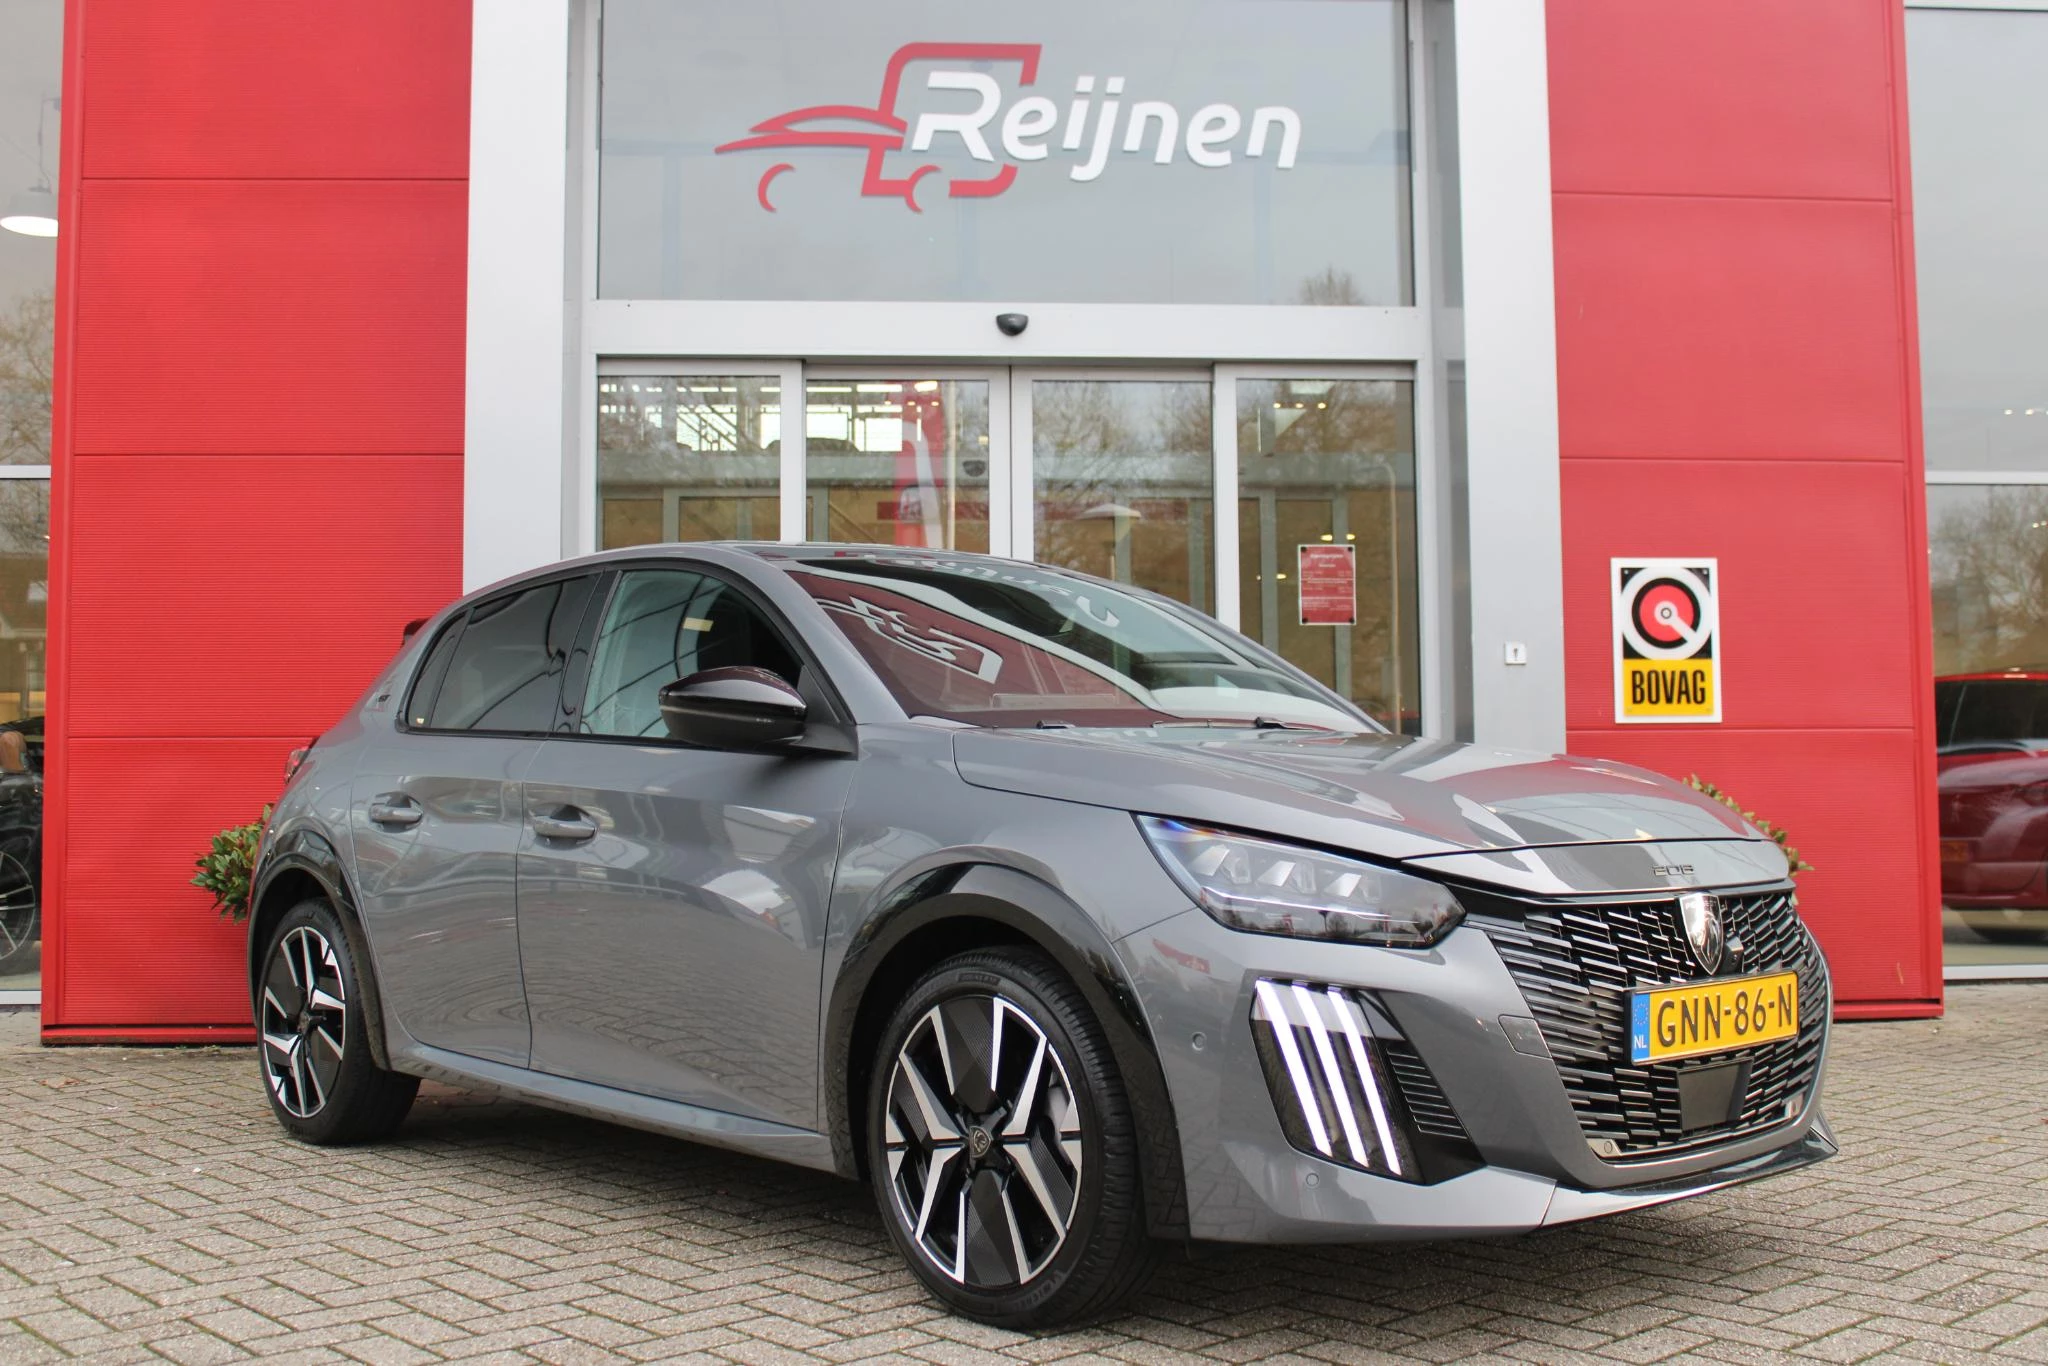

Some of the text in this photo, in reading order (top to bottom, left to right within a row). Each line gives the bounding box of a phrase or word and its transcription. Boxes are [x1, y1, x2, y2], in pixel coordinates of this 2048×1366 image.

[911, 70, 1301, 182] Reijnen
[1631, 669, 1706, 705] BOVAG
[1657, 983, 1792, 1048] GNN-86-N
[1634, 1035, 1648, 1050] NL
